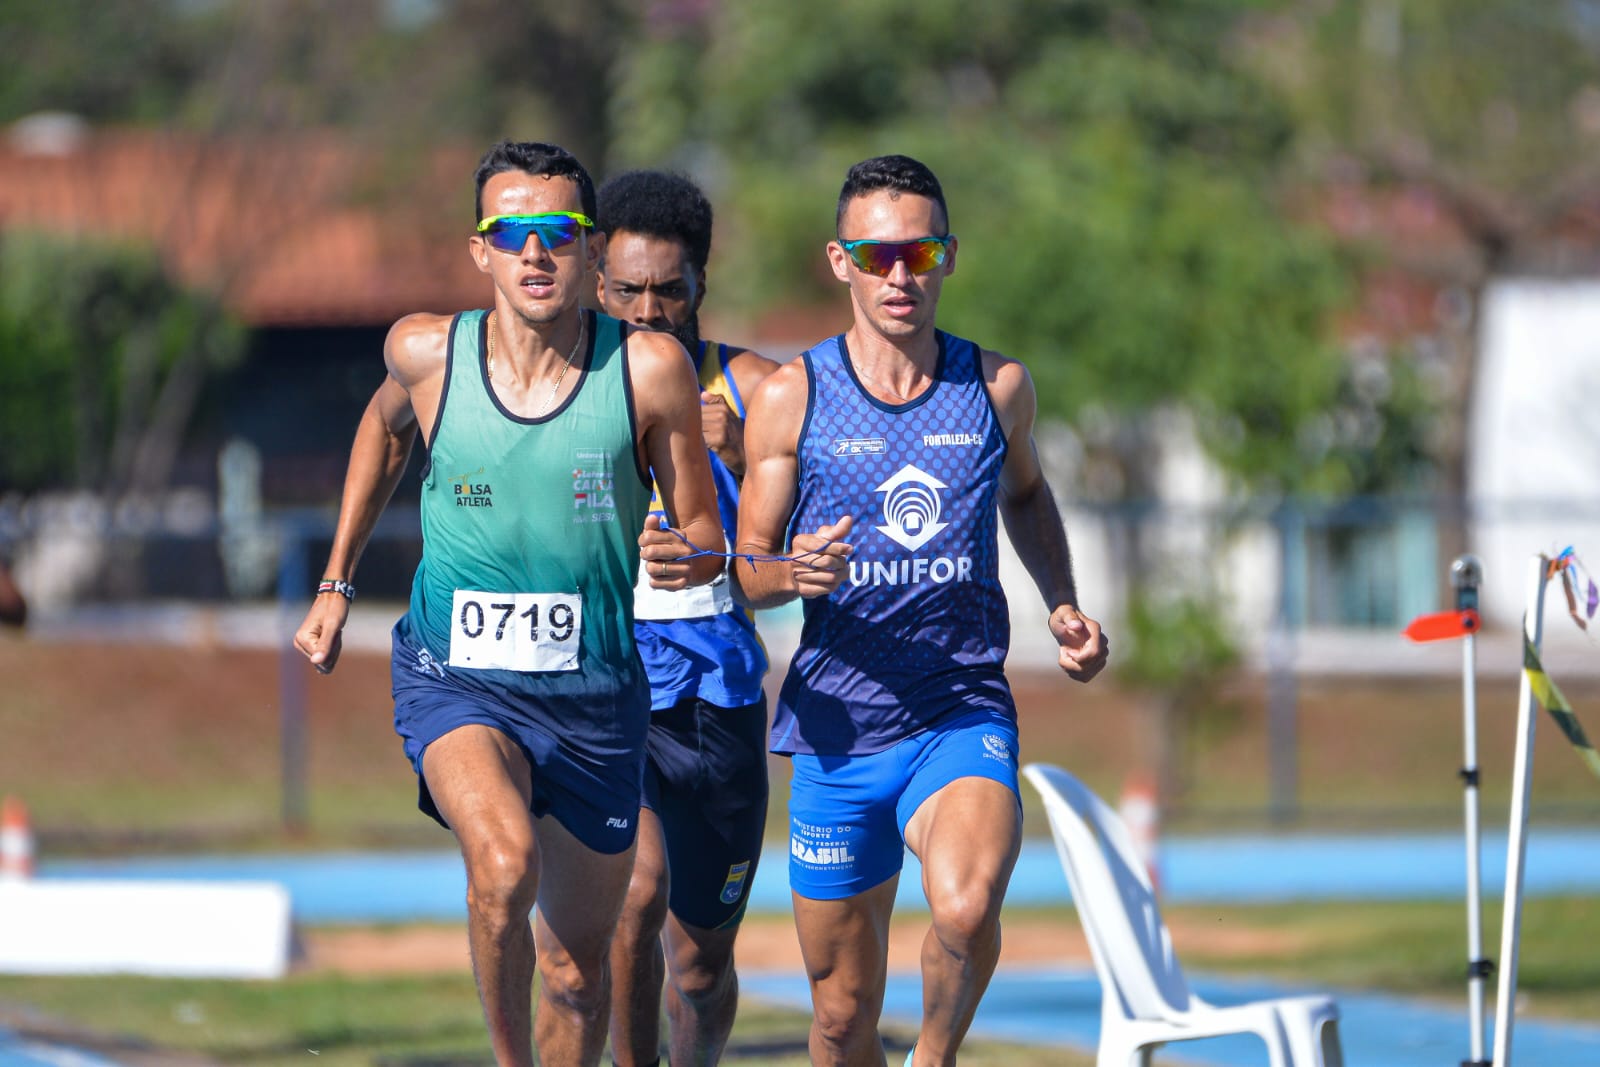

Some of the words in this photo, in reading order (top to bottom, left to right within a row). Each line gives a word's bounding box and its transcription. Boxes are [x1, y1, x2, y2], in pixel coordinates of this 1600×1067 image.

[923, 434, 983, 446] FORTALEZA-CE
[454, 484, 493, 496] BOLSA
[456, 496, 493, 507] ATLETA
[574, 493, 615, 509] FILA
[849, 557, 973, 587] UNIFOR
[460, 600, 575, 642] 0719
[606, 817, 628, 829] FILA
[791, 837, 855, 864] BRASIL
